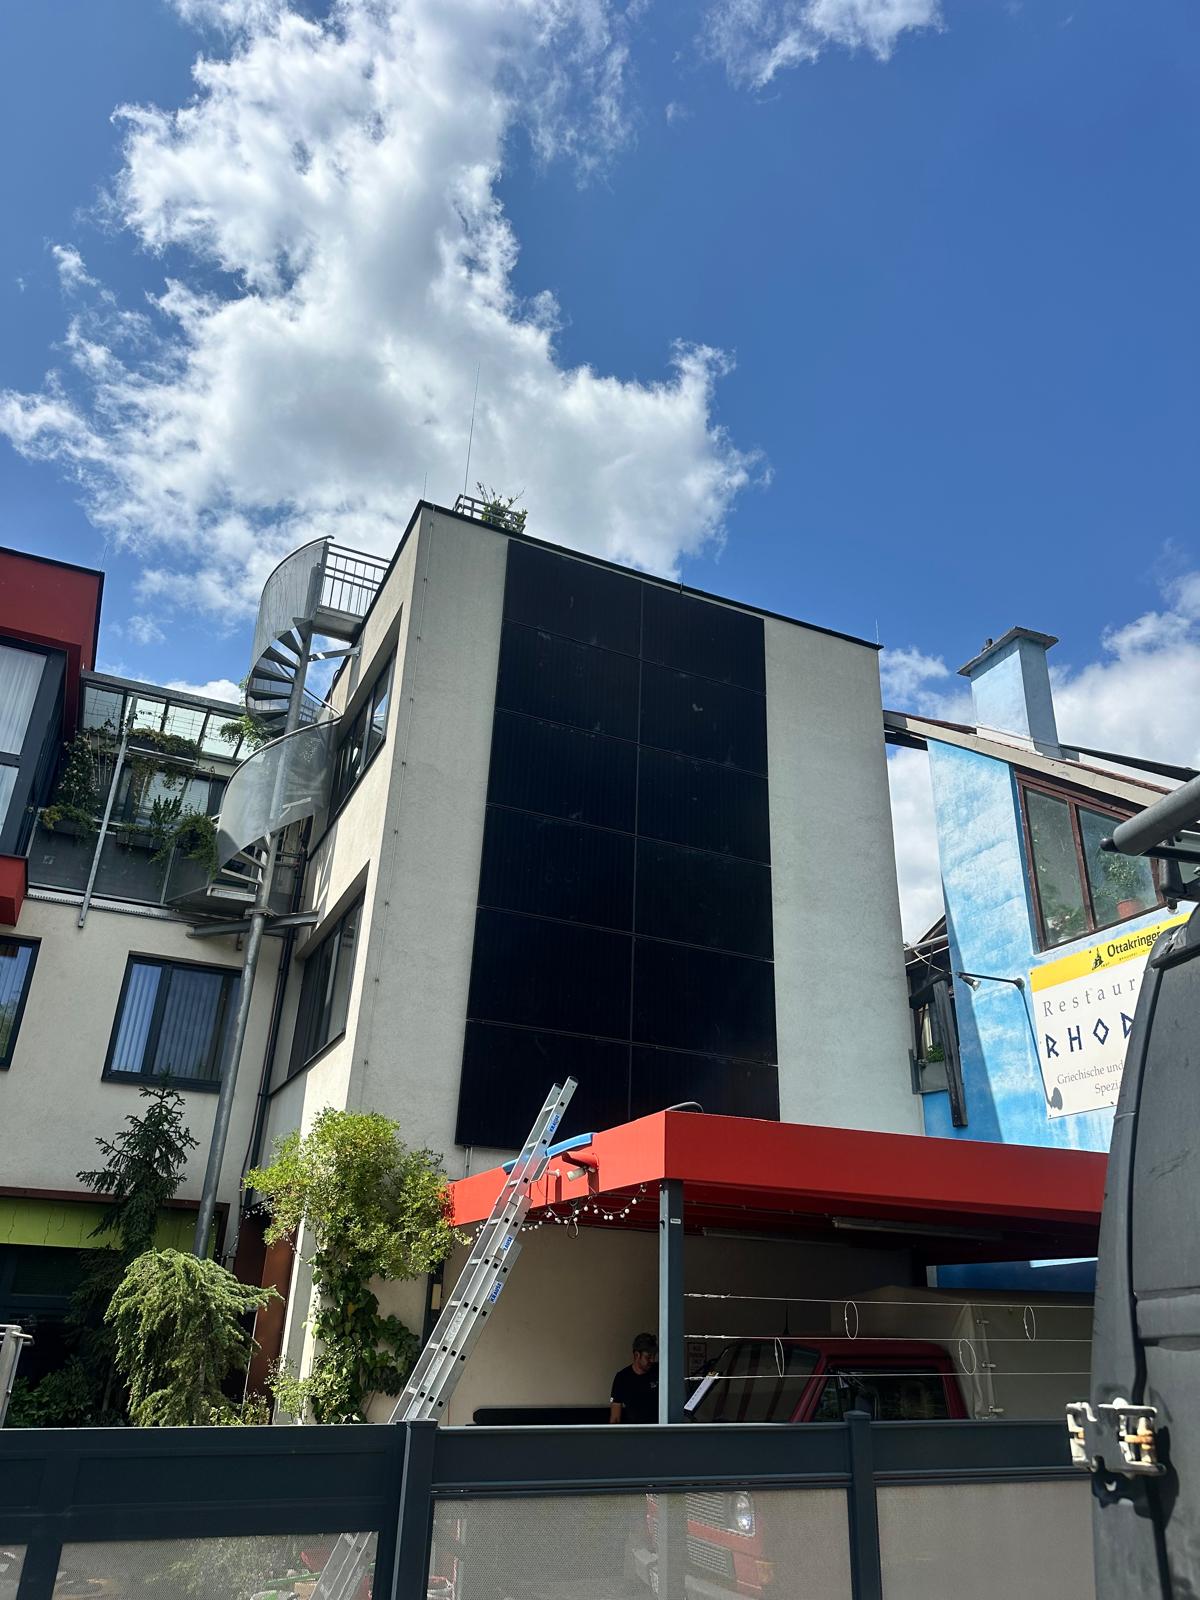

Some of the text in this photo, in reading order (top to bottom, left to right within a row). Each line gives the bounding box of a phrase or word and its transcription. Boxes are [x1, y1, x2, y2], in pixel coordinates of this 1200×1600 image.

[1107, 931, 1160, 957] Ottakringer
[1057, 1059, 1124, 1084] Griechische und
[1095, 1079, 1121, 1096] Spezi
